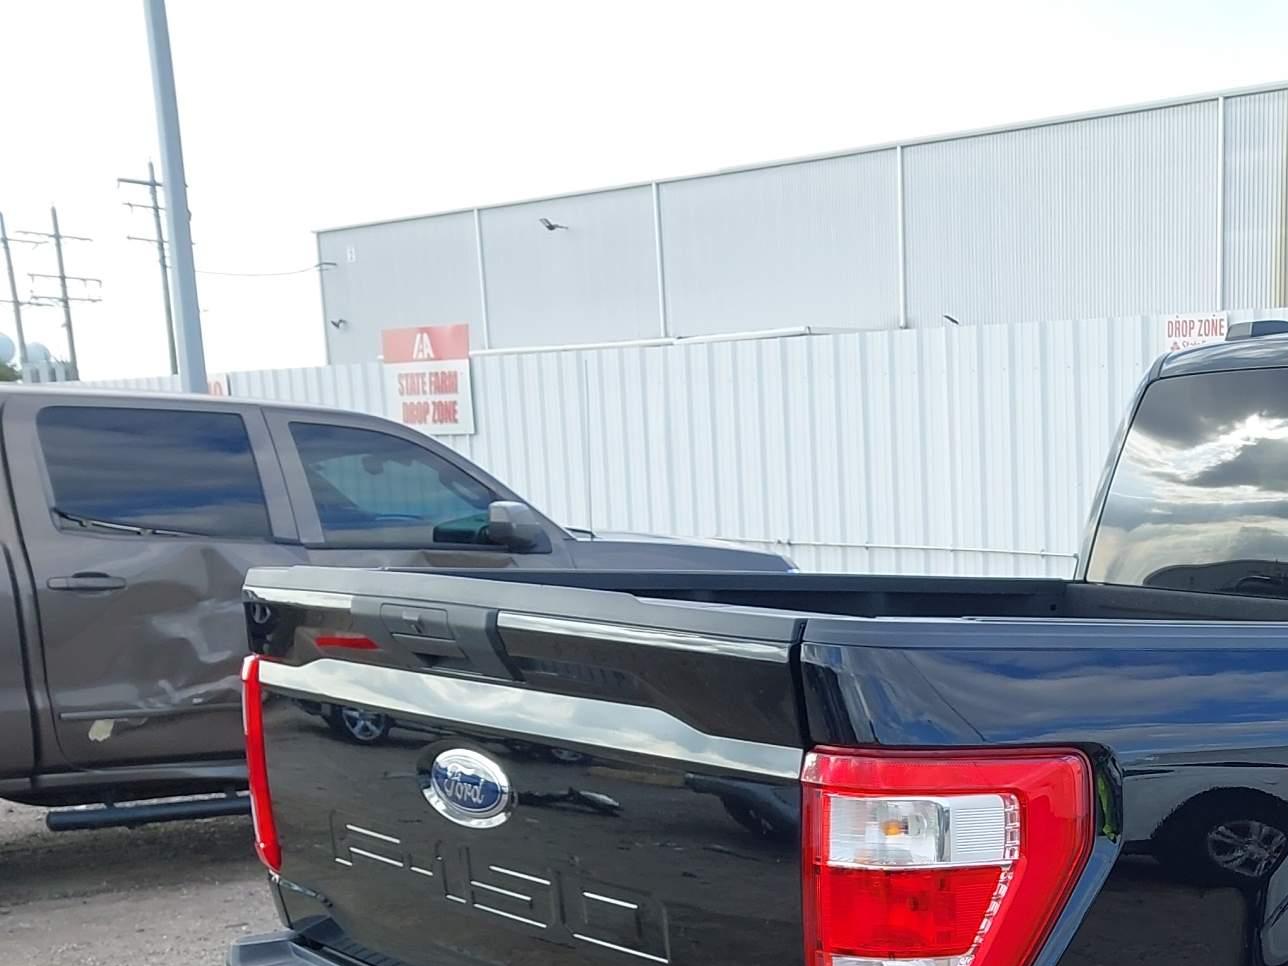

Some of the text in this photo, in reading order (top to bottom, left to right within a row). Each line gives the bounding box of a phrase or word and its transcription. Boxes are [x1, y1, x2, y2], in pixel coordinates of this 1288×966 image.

[1167, 318, 1225, 338] DROP ZONE
[398, 370, 459, 396] STATE FARM
[402, 400, 459, 425] DROP ZONE
[443, 763, 485, 804] Ford
